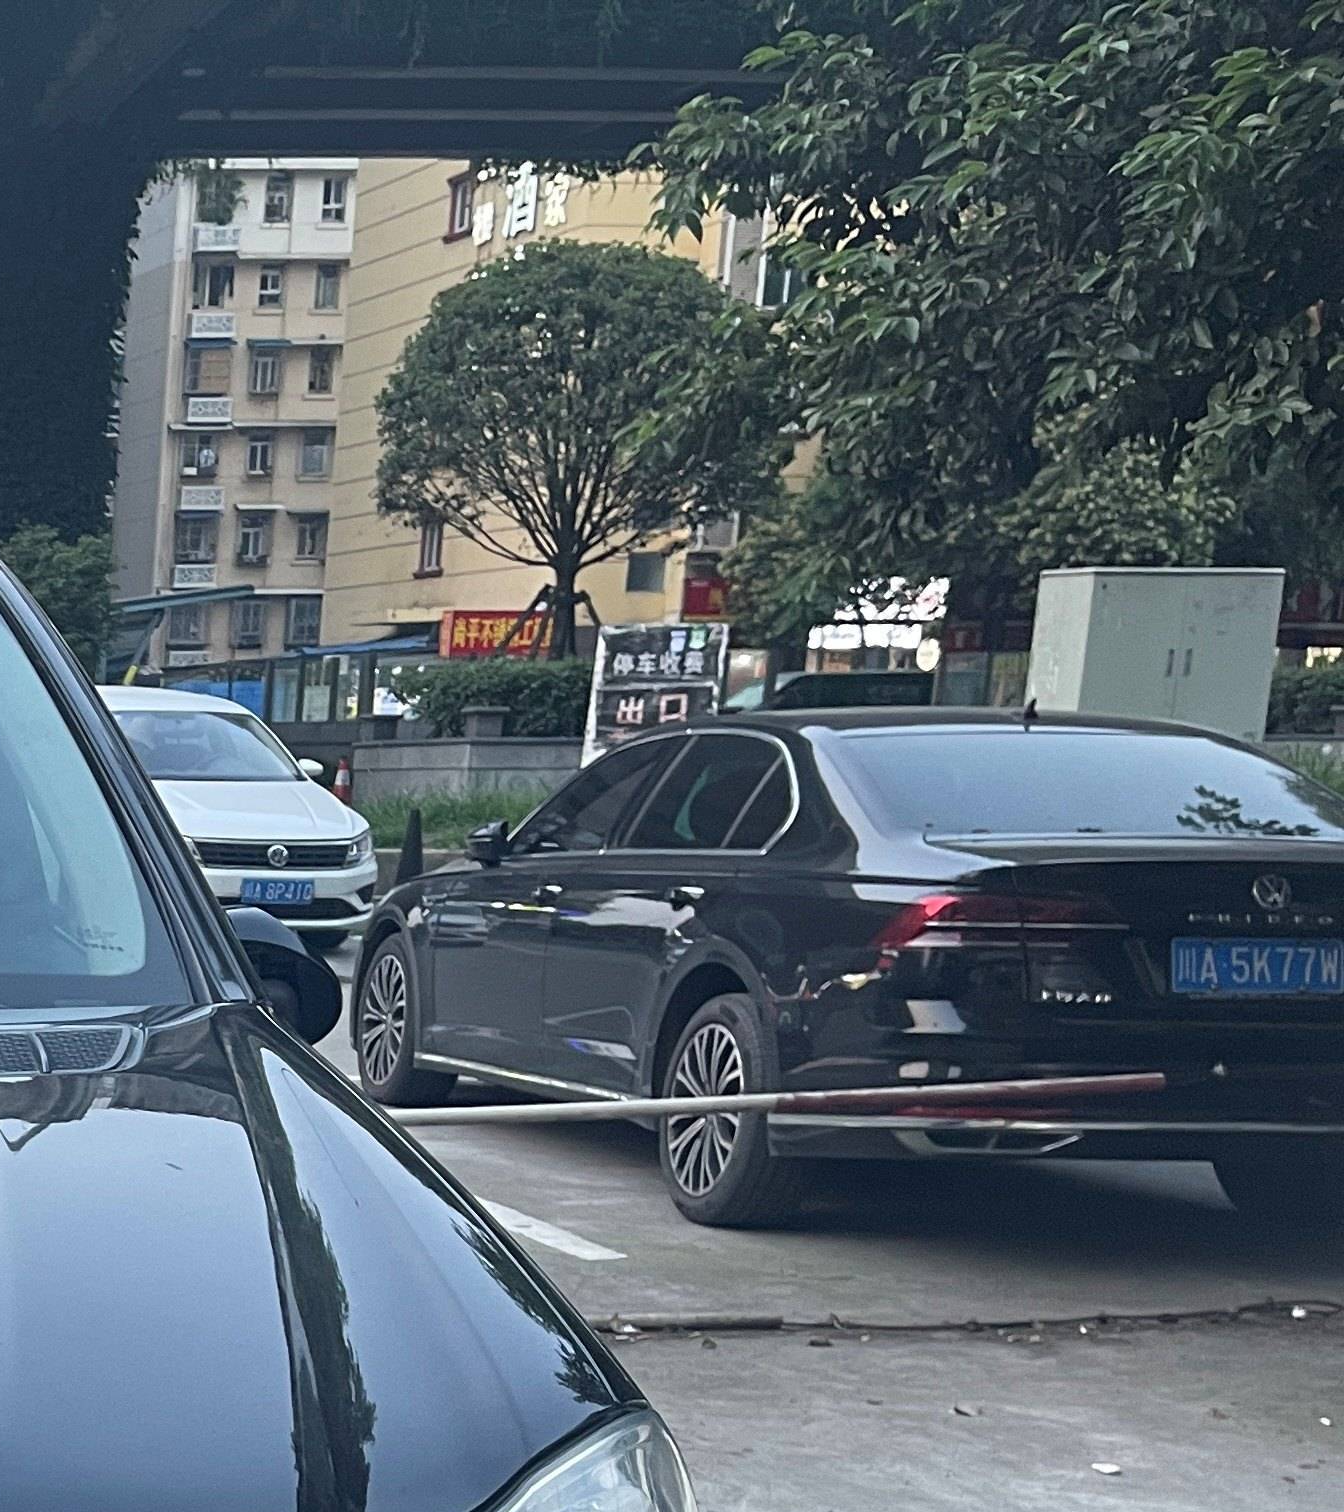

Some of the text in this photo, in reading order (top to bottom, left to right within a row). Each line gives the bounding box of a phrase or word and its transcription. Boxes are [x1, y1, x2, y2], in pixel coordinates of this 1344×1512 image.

[612, 650, 705, 676] 停车收费
[615, 694, 689, 724] 出口
